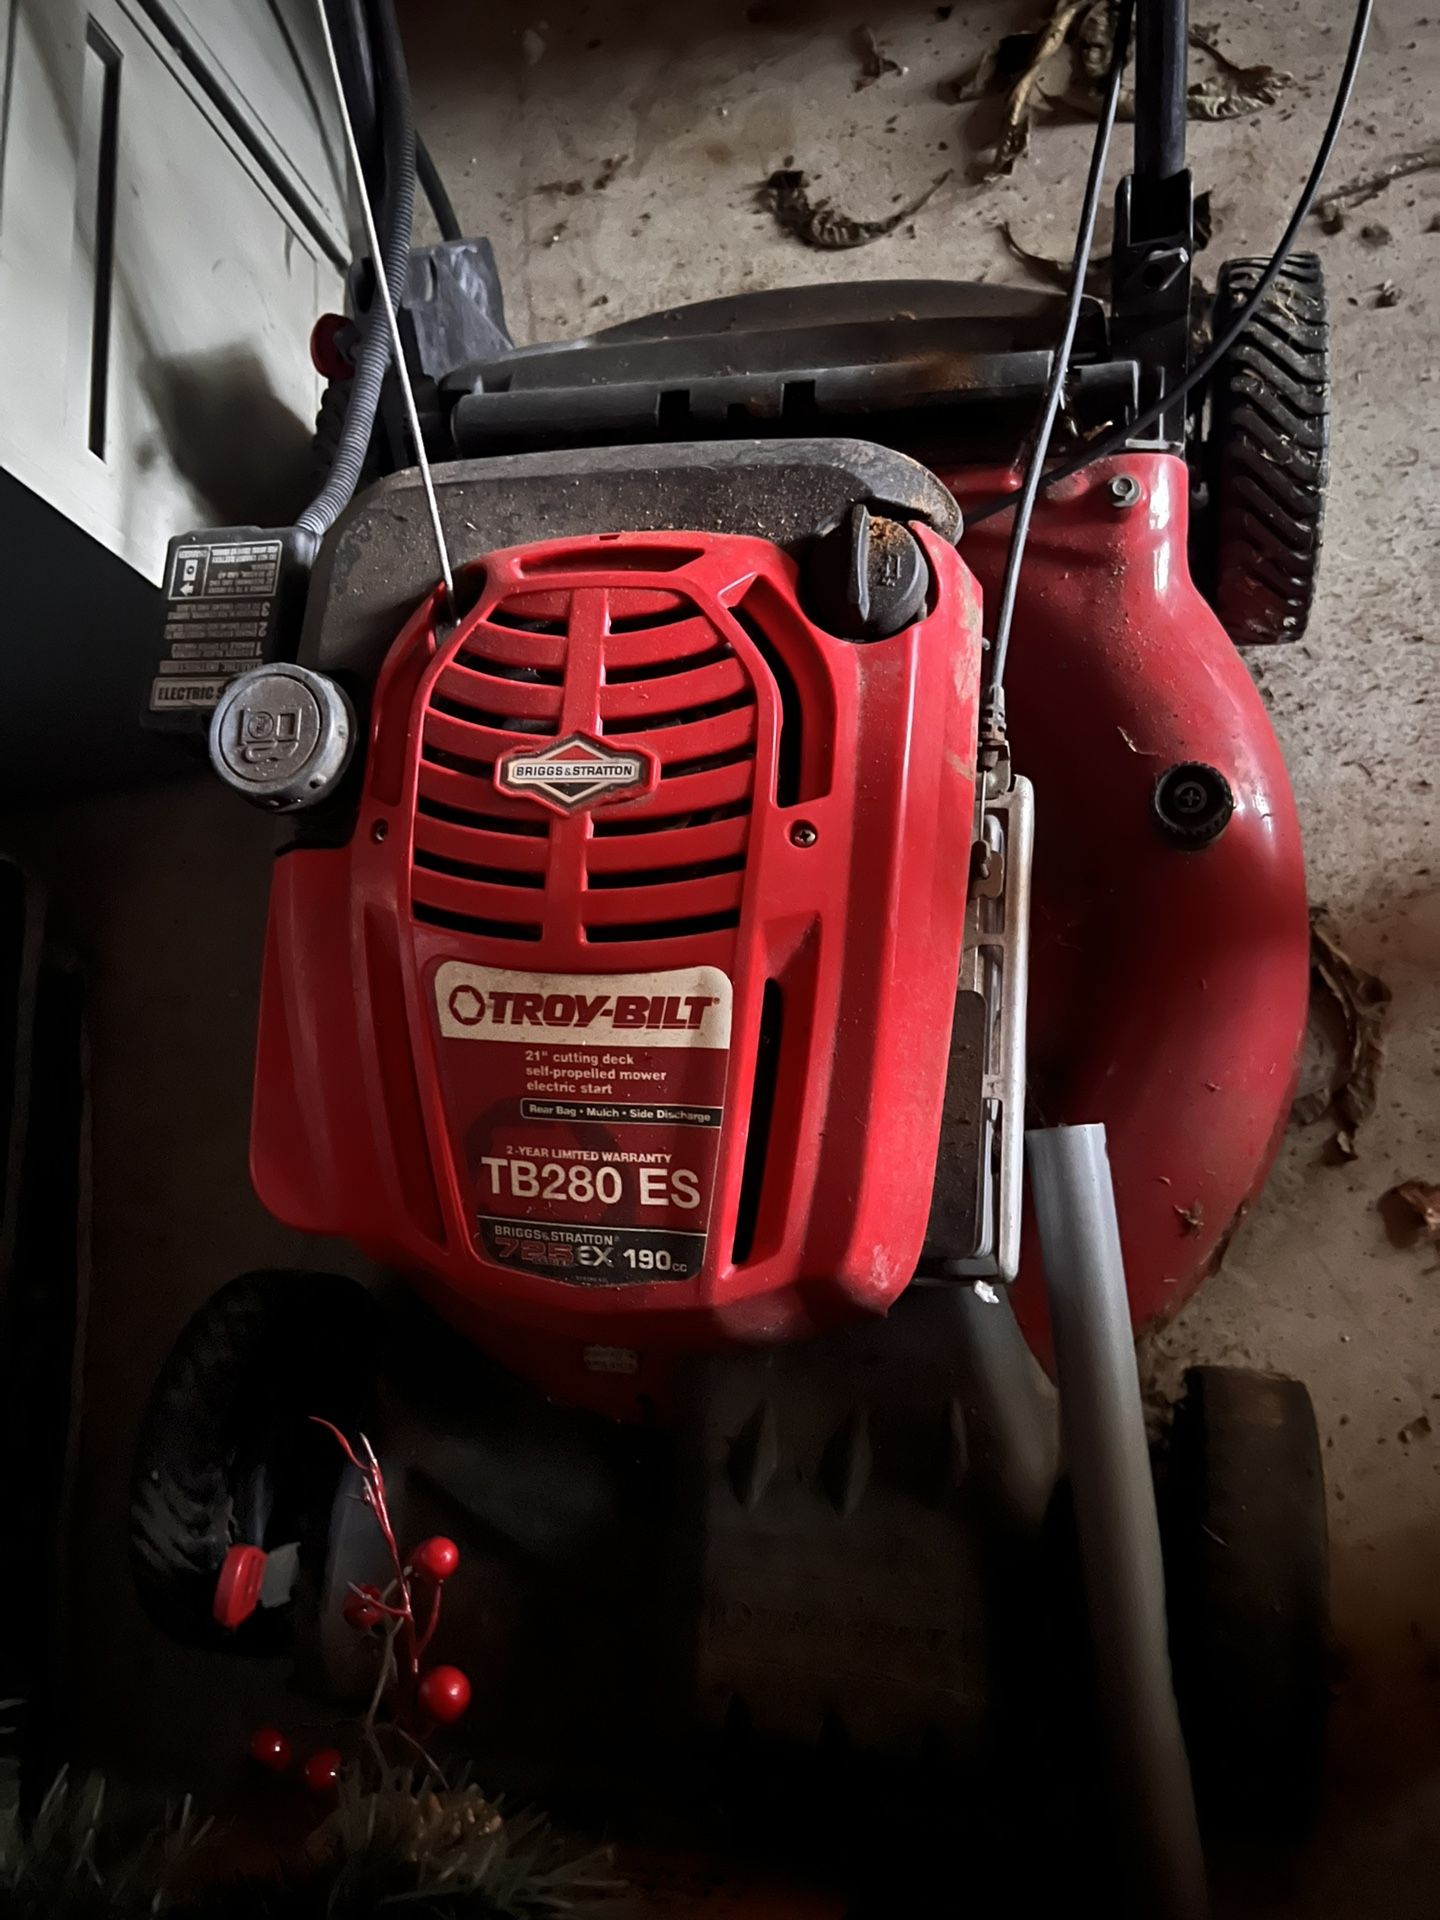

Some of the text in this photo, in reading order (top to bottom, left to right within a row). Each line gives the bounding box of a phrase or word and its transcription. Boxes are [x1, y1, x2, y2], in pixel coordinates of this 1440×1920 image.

[158, 686, 214, 700] ELECTRIC
[488, 991, 713, 1030] TROY-BILT
[553, 1053, 598, 1066] cutting
[602, 1054, 634, 1065] deck
[526, 1066, 667, 1081] self-propelled mower
[527, 1081, 613, 1095] electric start
[529, 1104, 711, 1122] Rear Bag Mulch Side Discharge
[552, 1149, 599, 1162] LIMITED
[602, 1151, 673, 1164] WARRANTY
[481, 1156, 701, 1209] TB280 ES
